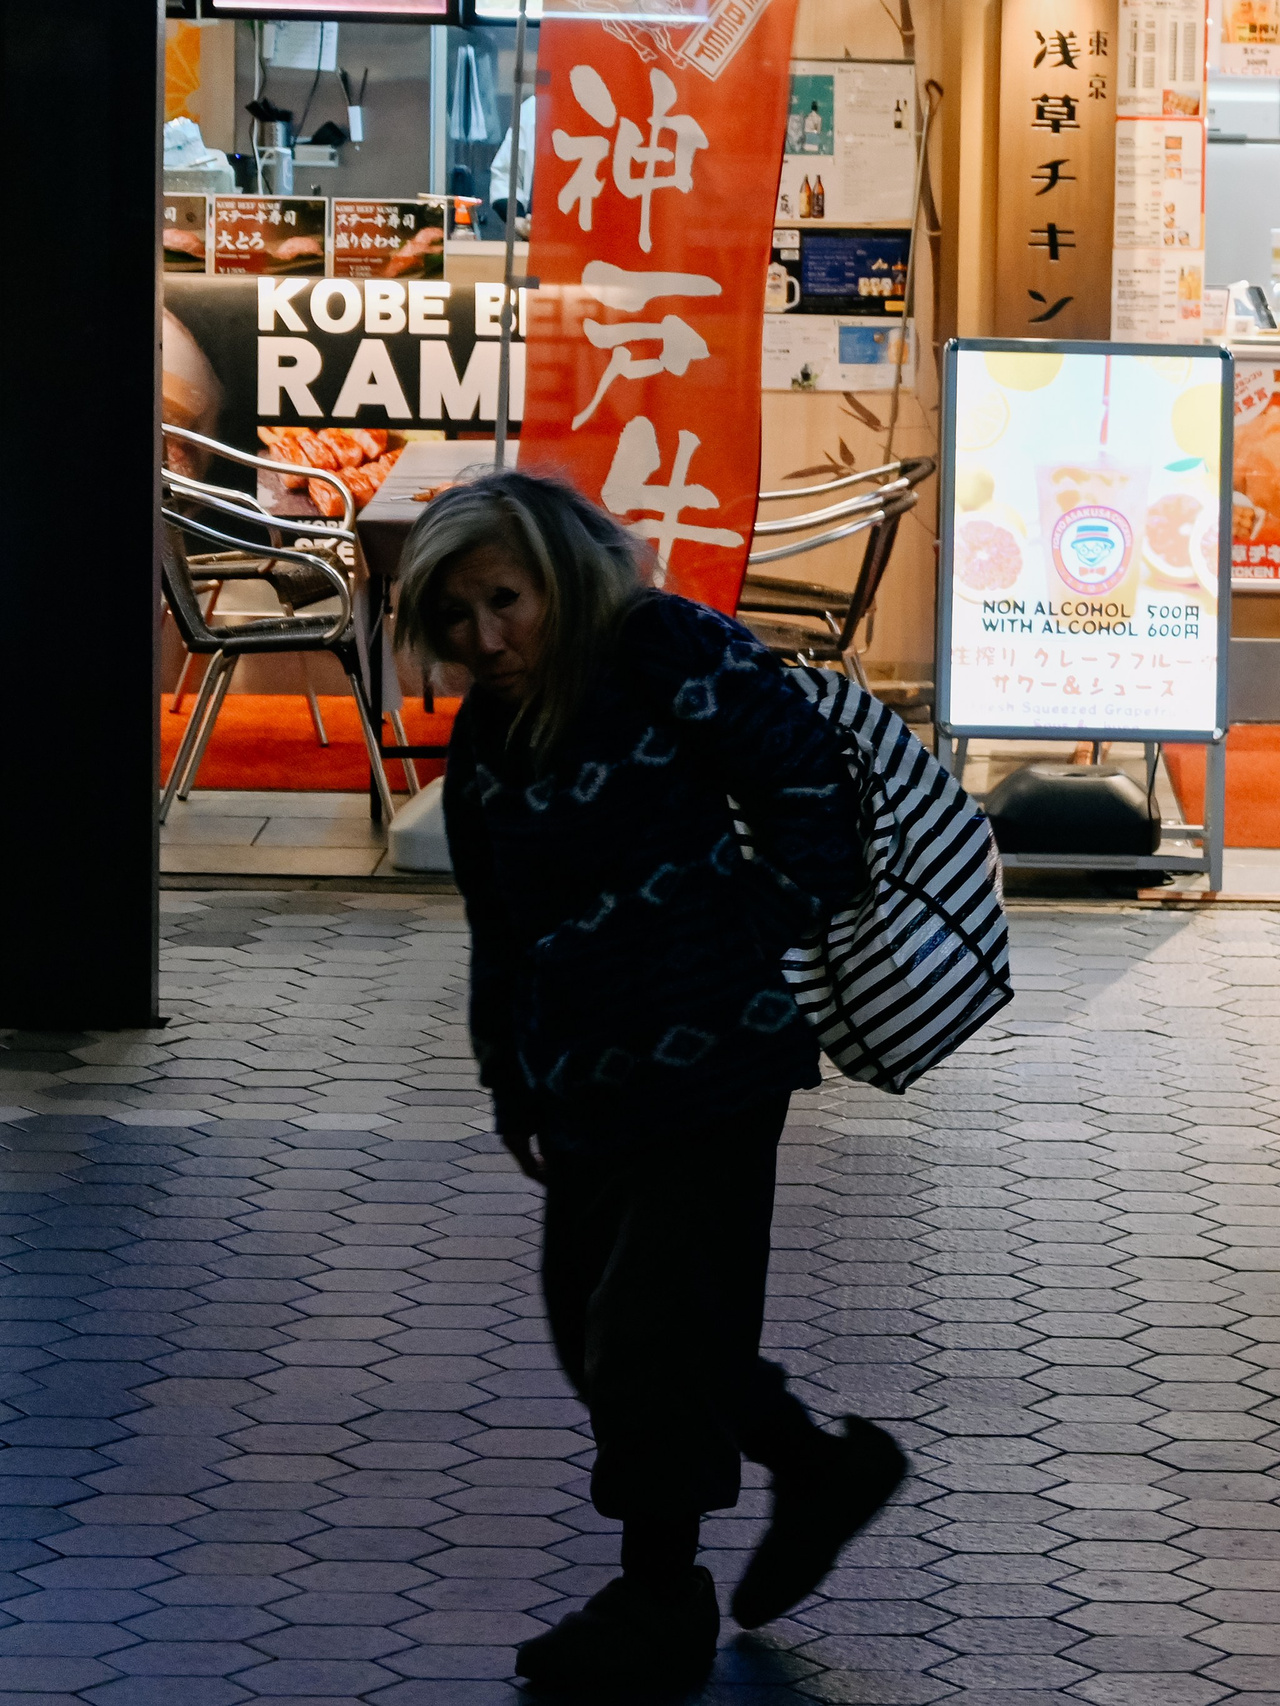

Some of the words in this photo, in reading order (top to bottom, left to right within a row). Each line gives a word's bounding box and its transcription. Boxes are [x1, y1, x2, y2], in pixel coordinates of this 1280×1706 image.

[1088, 30, 1109, 99] 東京
[1027, 30, 1081, 323] 浅草チキン
[216, 210, 297, 226] ステーキ寿司
[216, 230, 265, 250] 大とろ
[257, 277, 450, 334] KOBE
[551, 65, 744, 588] 神戸牛
[1066, 508, 1111, 524] ASAKUSA
[983, 600, 1025, 615] NON
[1034, 600, 1131, 618] ALCOHOL
[1147, 604, 1199, 622] 500円
[981, 618, 1033, 633] WITH
[1042, 619, 1138, 636] ALCOHOL
[1147, 623, 1199, 639] 600円
[1022, 701, 1097, 717] Squeezed
